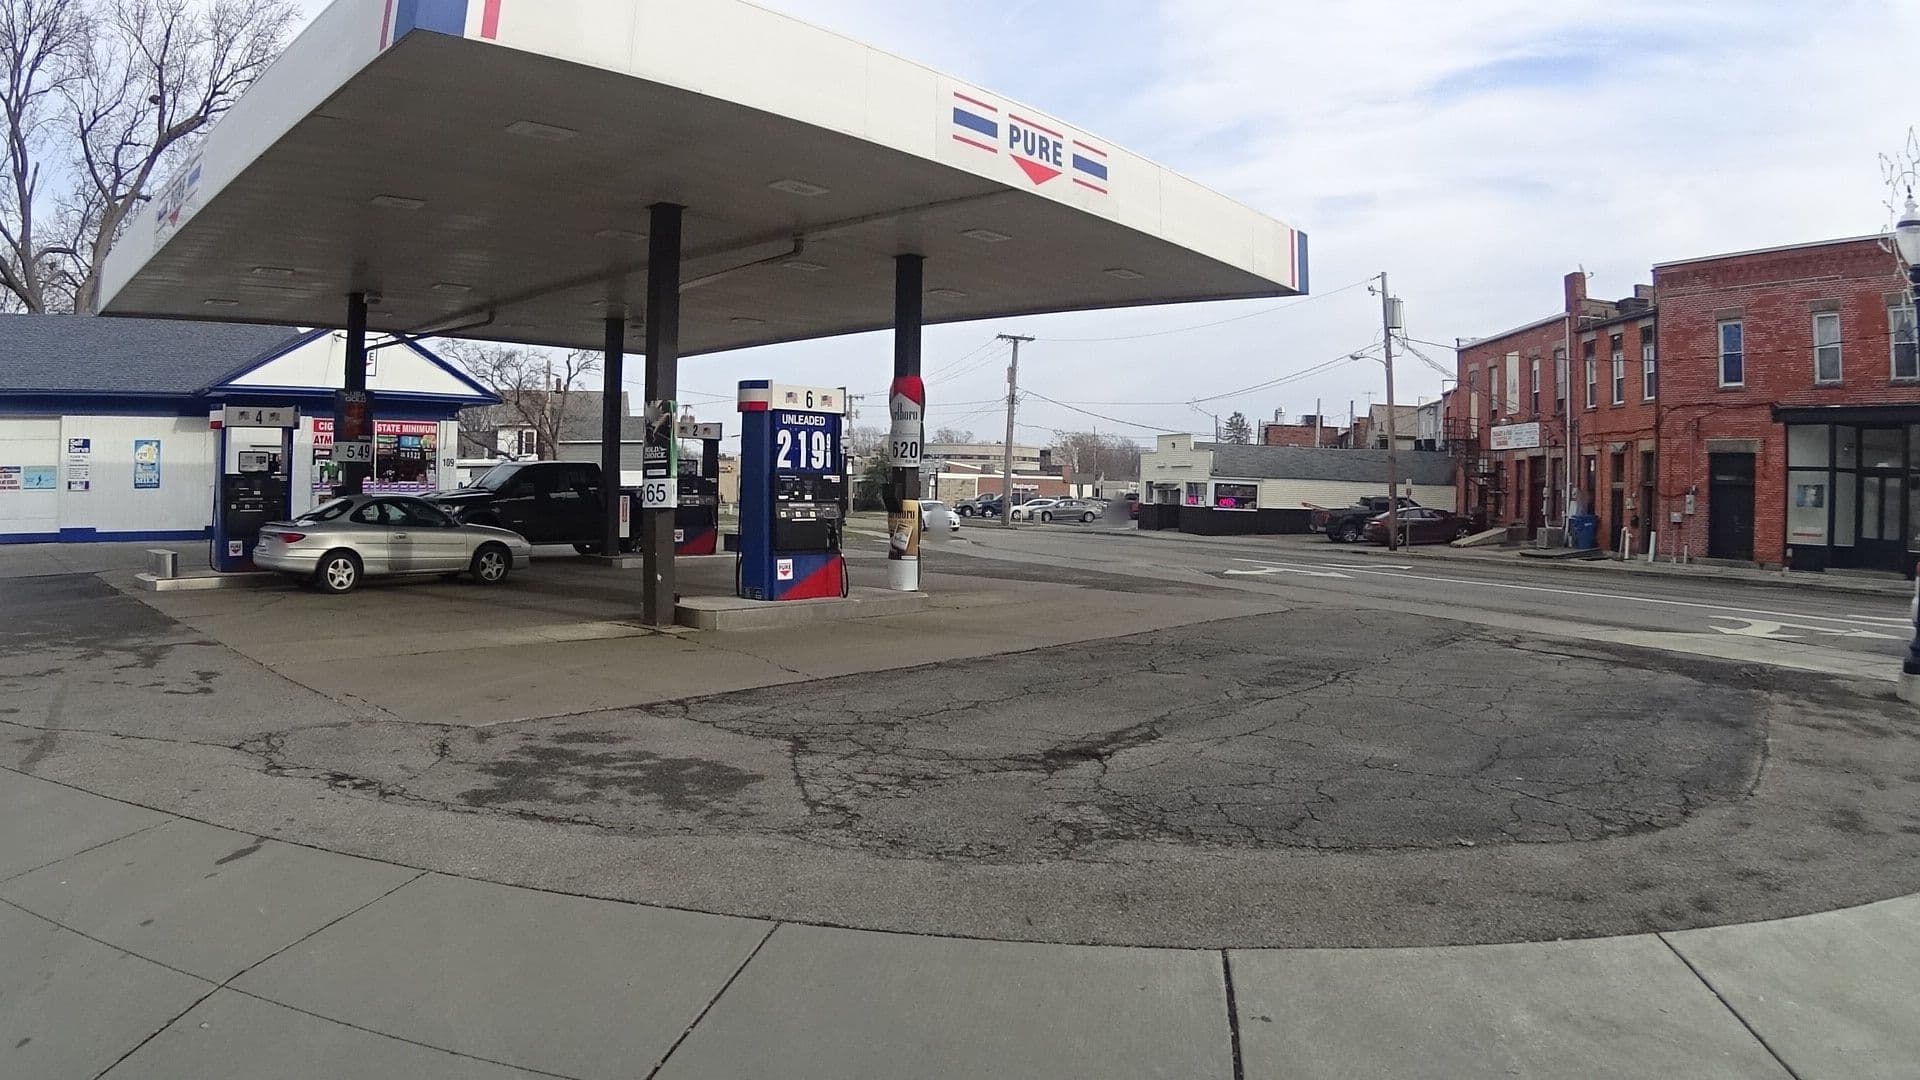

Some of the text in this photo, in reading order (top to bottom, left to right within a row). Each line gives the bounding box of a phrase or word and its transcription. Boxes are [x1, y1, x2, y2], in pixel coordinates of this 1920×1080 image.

[1009, 123, 1063, 168] PURE
[806, 390, 813, 409] 6
[255, 410, 263, 425] 4
[782, 413, 826, 426] UNLEADED
[377, 423, 436, 434] STATE MINIMUM
[692, 424, 698, 436] 2
[313, 435, 332, 445] ATM
[892, 441, 918, 458] 620
[443, 458, 455, 467] 109
